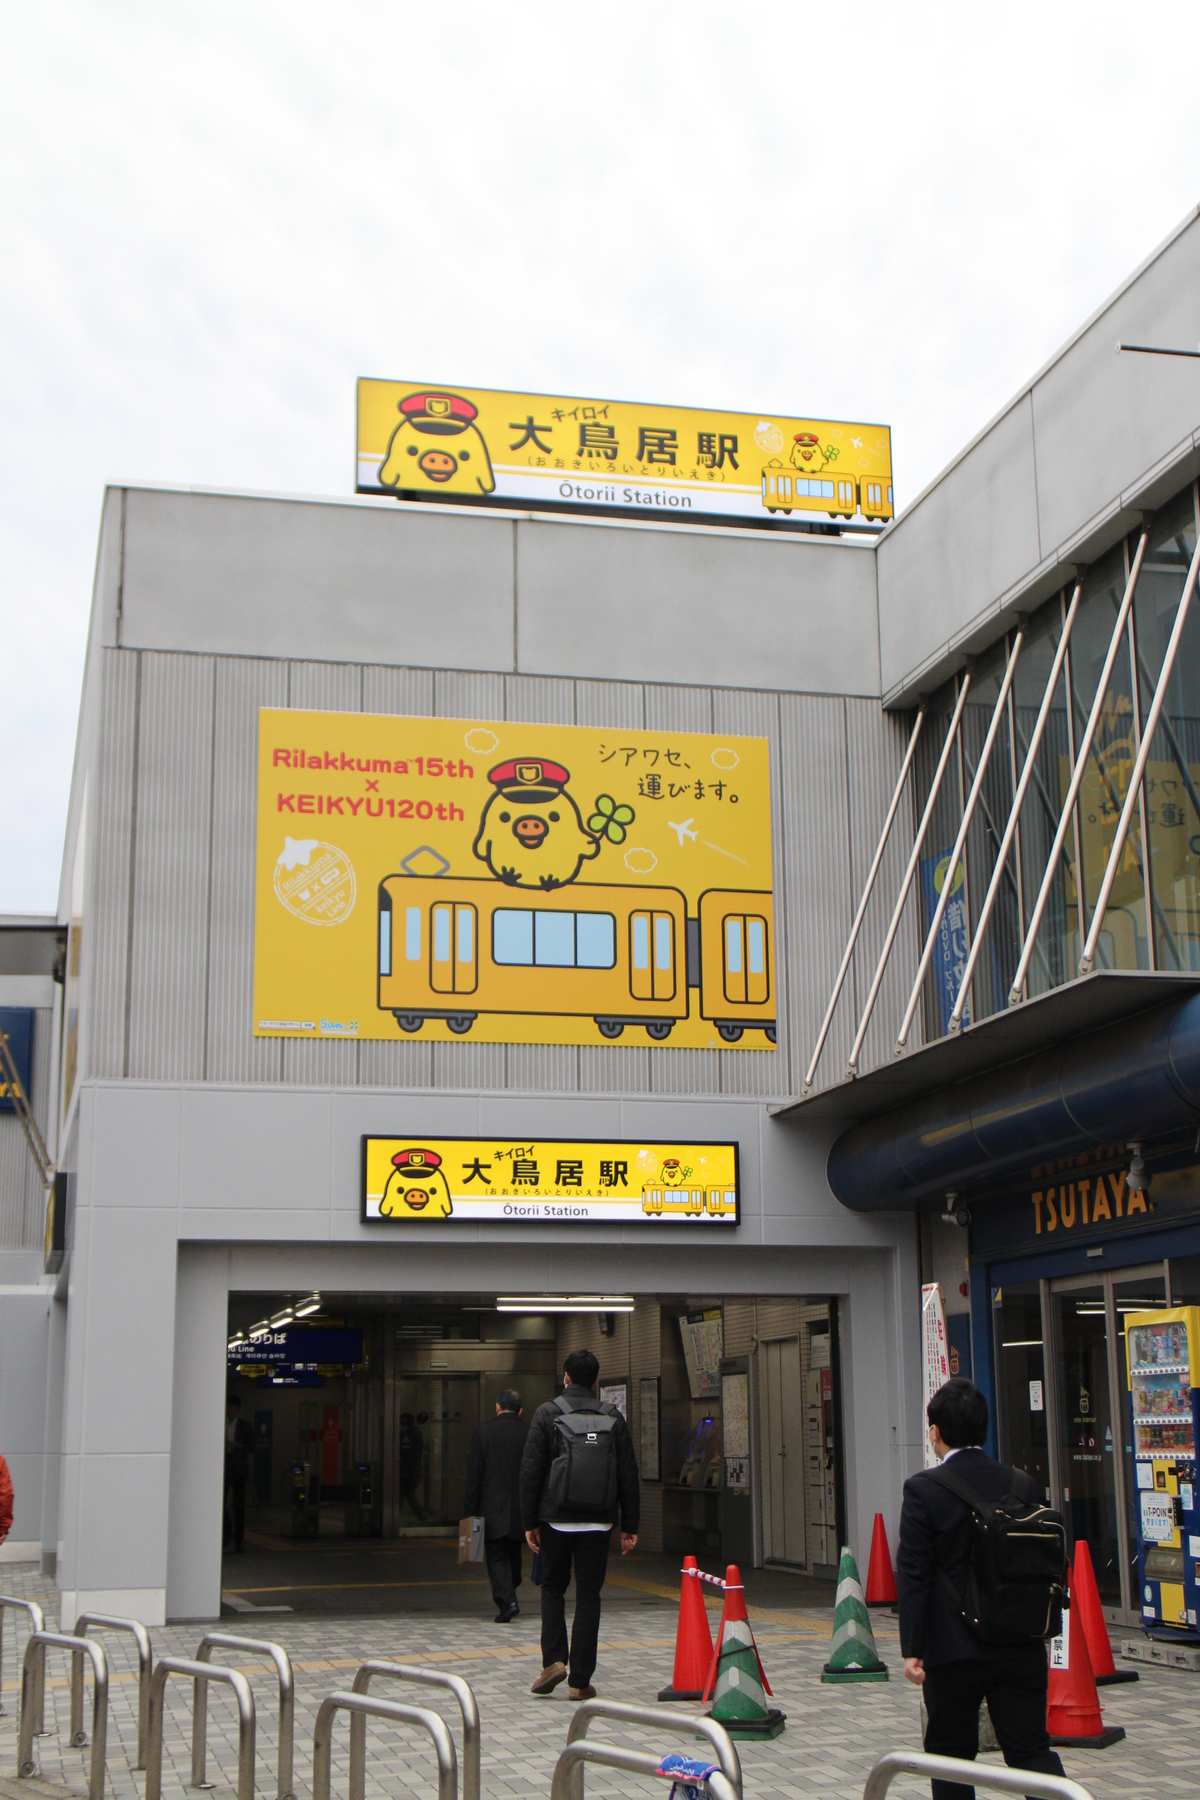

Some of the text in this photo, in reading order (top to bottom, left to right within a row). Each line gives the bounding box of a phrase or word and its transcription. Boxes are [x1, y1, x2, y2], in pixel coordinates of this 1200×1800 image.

[552, 405, 610, 422] キイロイ
[509, 415, 740, 471] 大鳥居駅
[559, 480, 692, 508] Ōtorii Station
[415, 757, 474, 779] 15th
[638, 773, 739, 804] 運びます。
[494, 1145, 535, 1161] キイロイ
[462, 1157, 628, 1187] 大鳥居駅
[544, 1205, 589, 1217] Station
[1031, 1170, 1148, 1235] TSUTAYA
